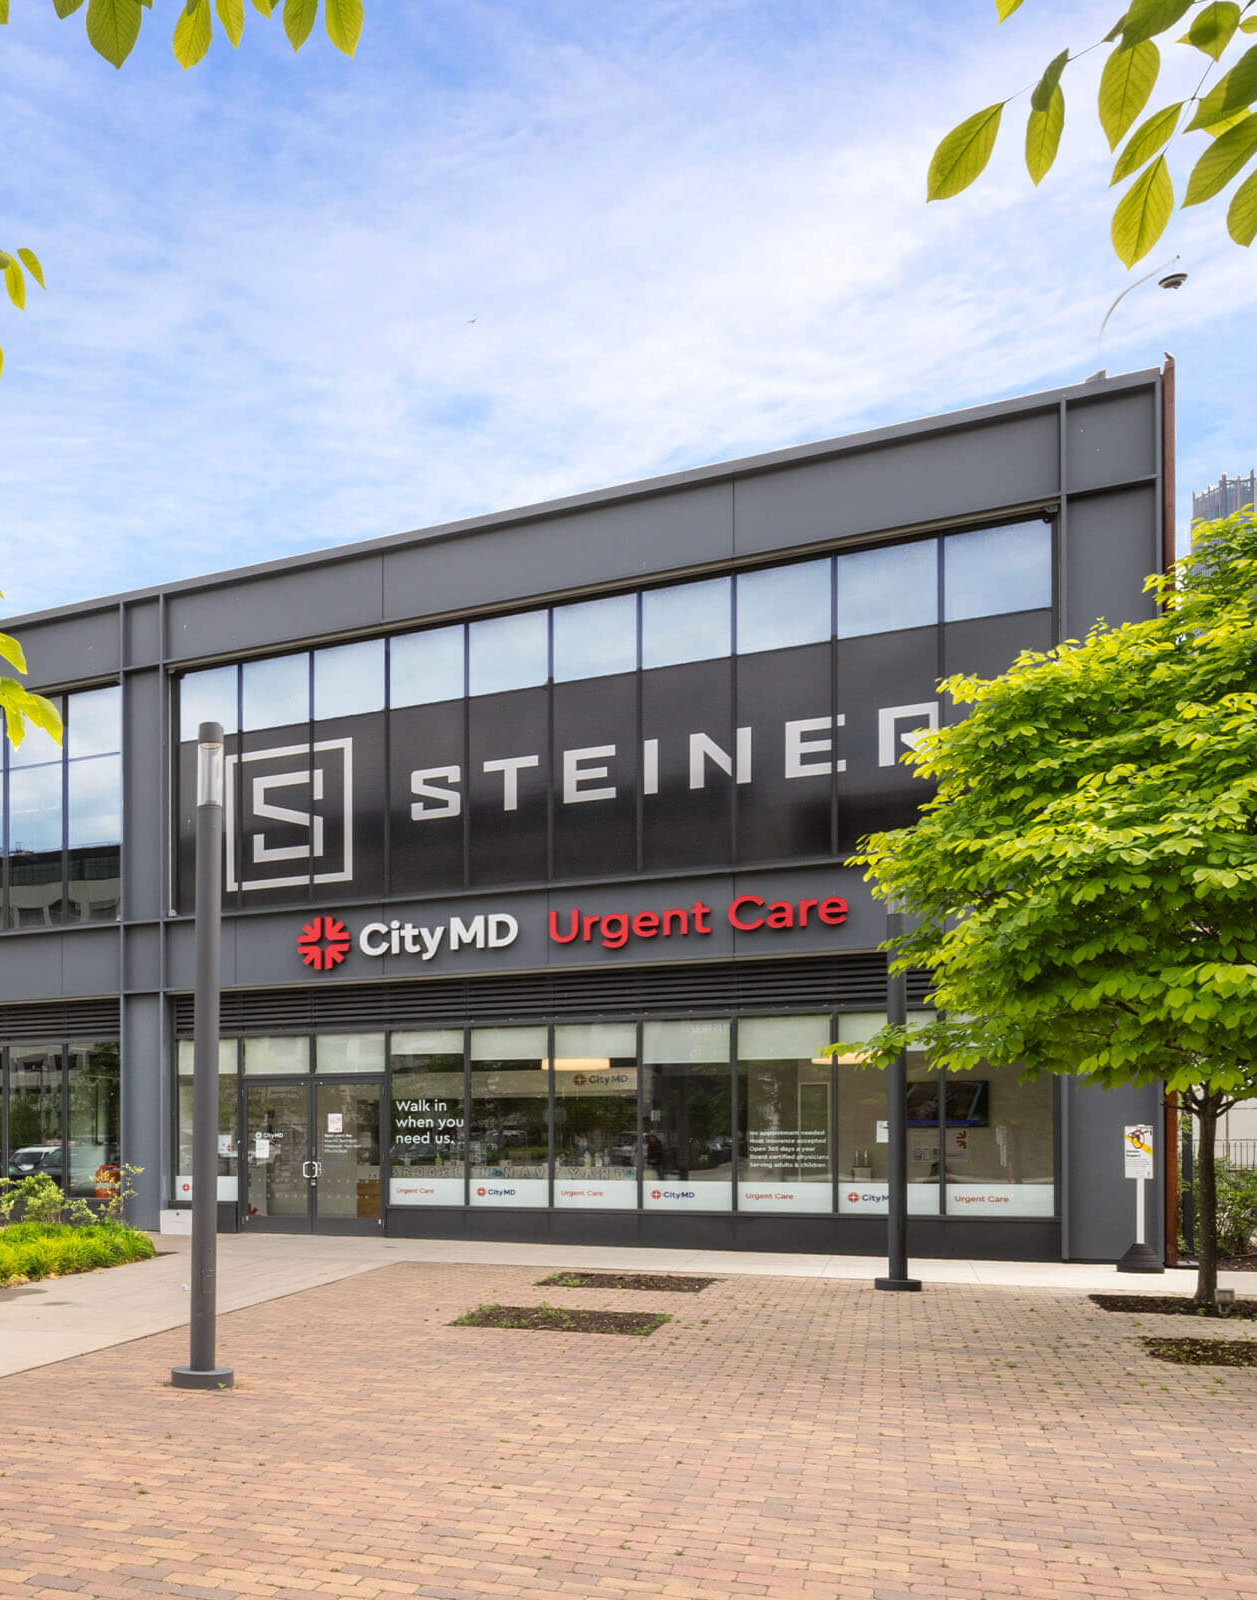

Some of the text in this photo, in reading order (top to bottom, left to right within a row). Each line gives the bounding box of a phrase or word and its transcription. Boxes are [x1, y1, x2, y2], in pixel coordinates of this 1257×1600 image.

[411, 701, 940, 821] STEINER
[358, 895, 849, 960] CityMD Urgent Care
[395, 1098, 447, 1112] Walk in
[395, 1115, 464, 1131] when you
[395, 1131, 456, 1145] need us.
[395, 1187, 418, 1195] Urgent
[560, 1190, 585, 1198] Urgent
[745, 1193, 773, 1201] Urgent
[861, 1194, 890, 1203] CityM
[954, 1195, 1010, 1204] Urgent Care
